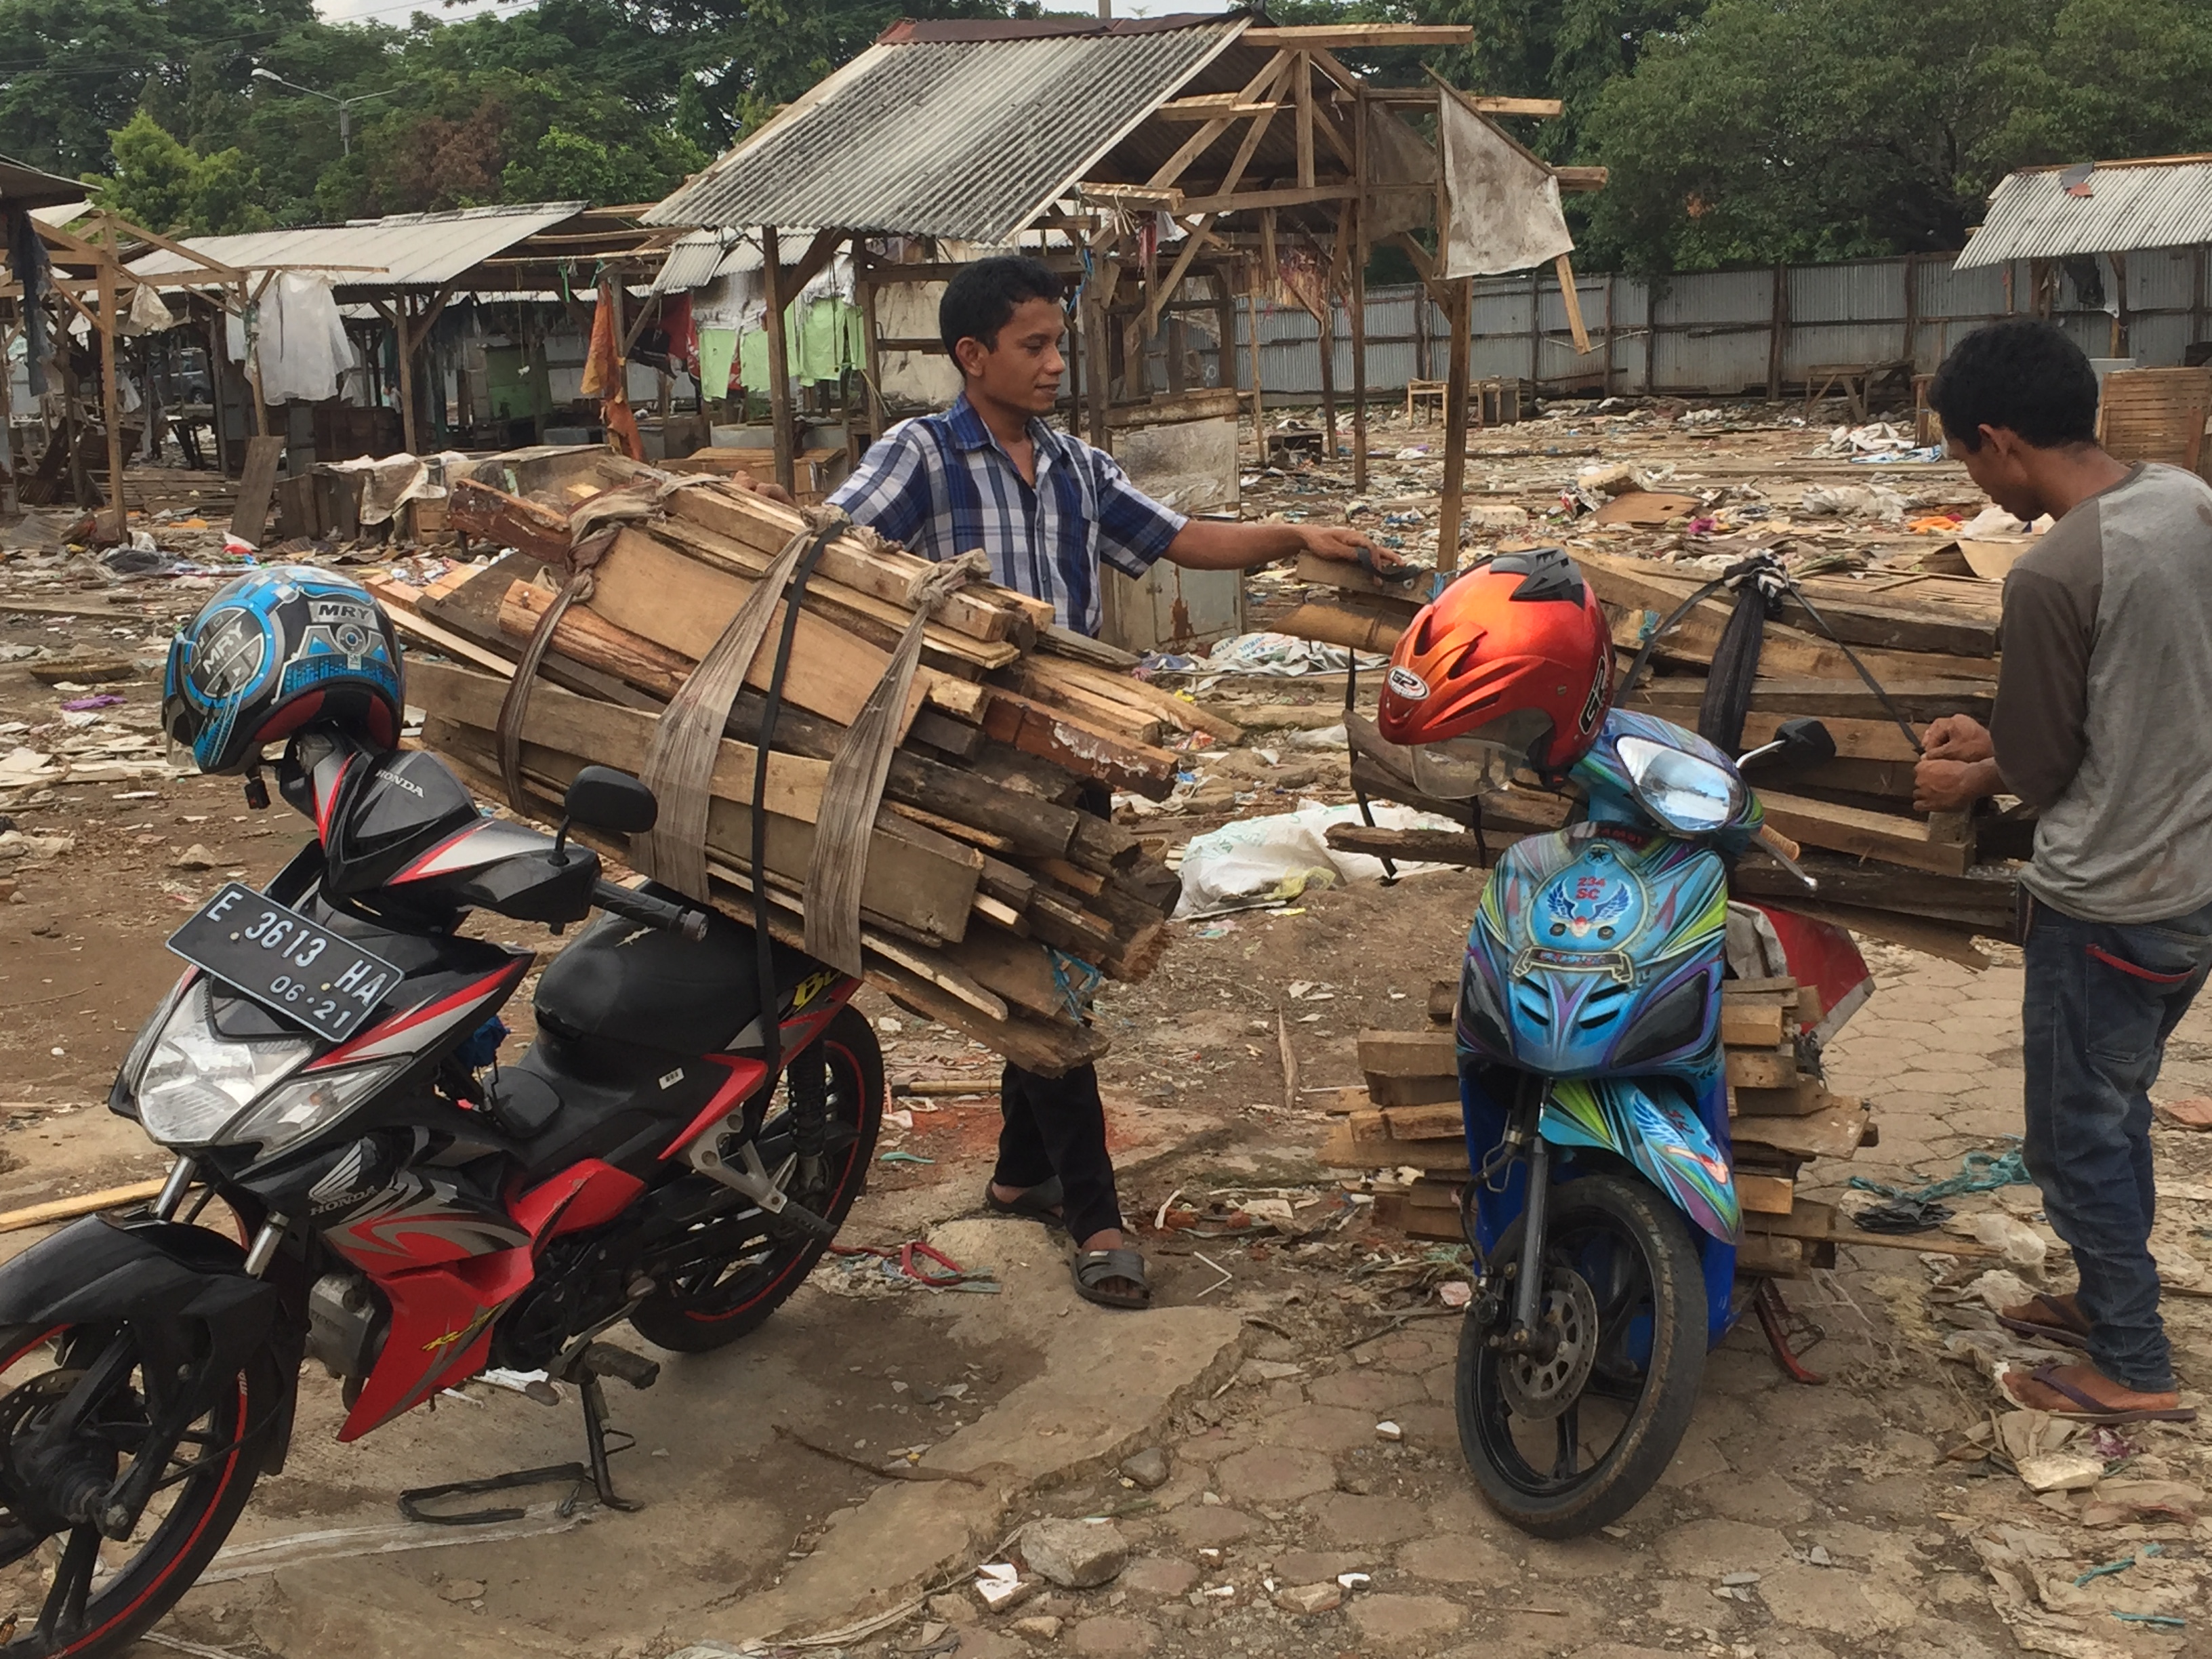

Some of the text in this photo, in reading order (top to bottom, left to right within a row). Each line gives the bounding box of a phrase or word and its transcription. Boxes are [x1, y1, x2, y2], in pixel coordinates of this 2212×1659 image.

[319, 605, 369, 619] MRY
[203, 621, 243, 674] MRY
[1391, 670, 1418, 688] G2
[375, 769, 424, 798] HONDA
[1576, 876, 1607, 887] 234
[1576, 888, 1601, 900] SC
[206, 890, 388, 1006] E 3613 HA
[310, 1185, 378, 1216] HONDA
